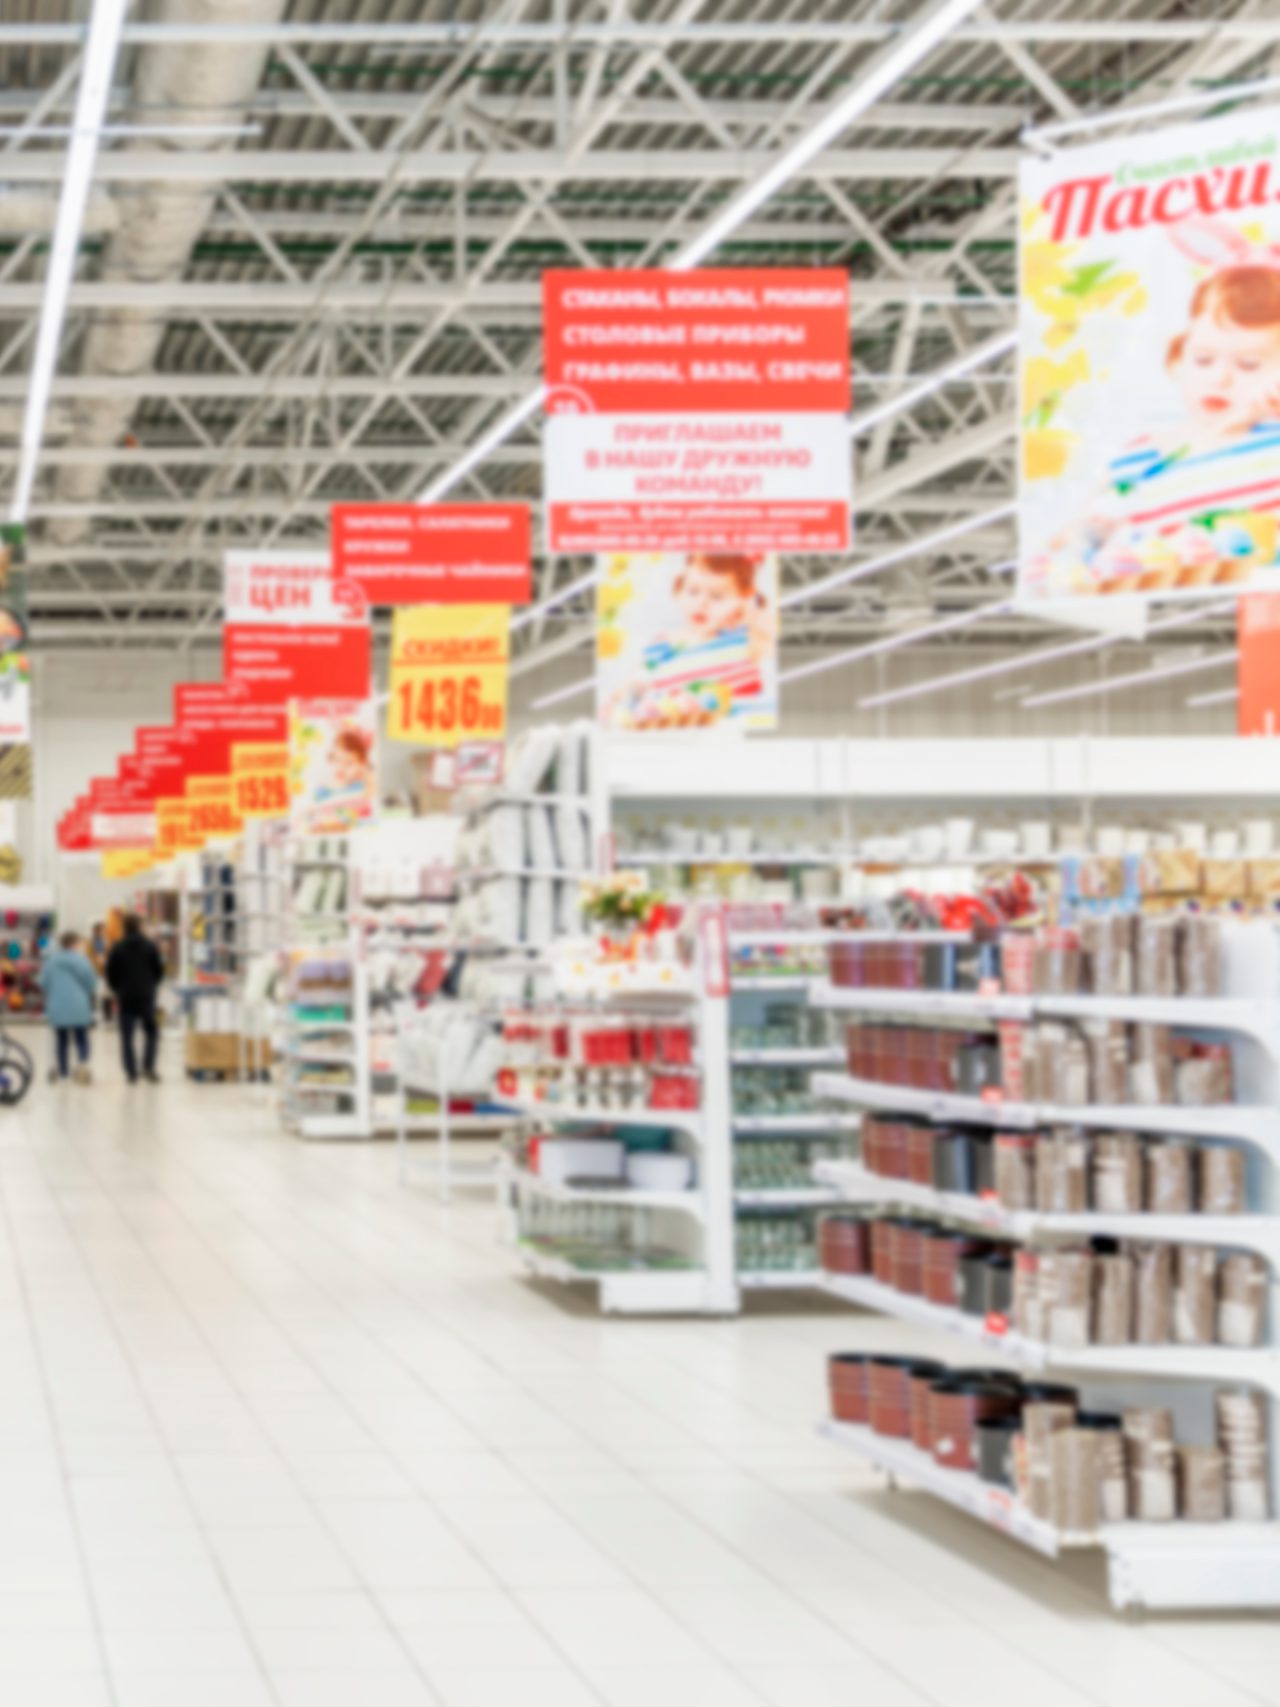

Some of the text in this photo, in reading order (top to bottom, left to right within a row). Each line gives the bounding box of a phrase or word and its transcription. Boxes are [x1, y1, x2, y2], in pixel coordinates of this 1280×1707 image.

[1041, 162, 1280, 242] Пасхи
[563, 325, 805, 344] СТОЛОВЫЕ ПРИБОРЫ
[614, 424, 782, 442] ПРИГЛАШАЕМ
[586, 449, 811, 471] В НАШУ ДРУЖНУЮ
[635, 475, 761, 496] КОМАНДУ!
[250, 586, 312, 612] ЦЕН
[399, 675, 480, 731] 1436
